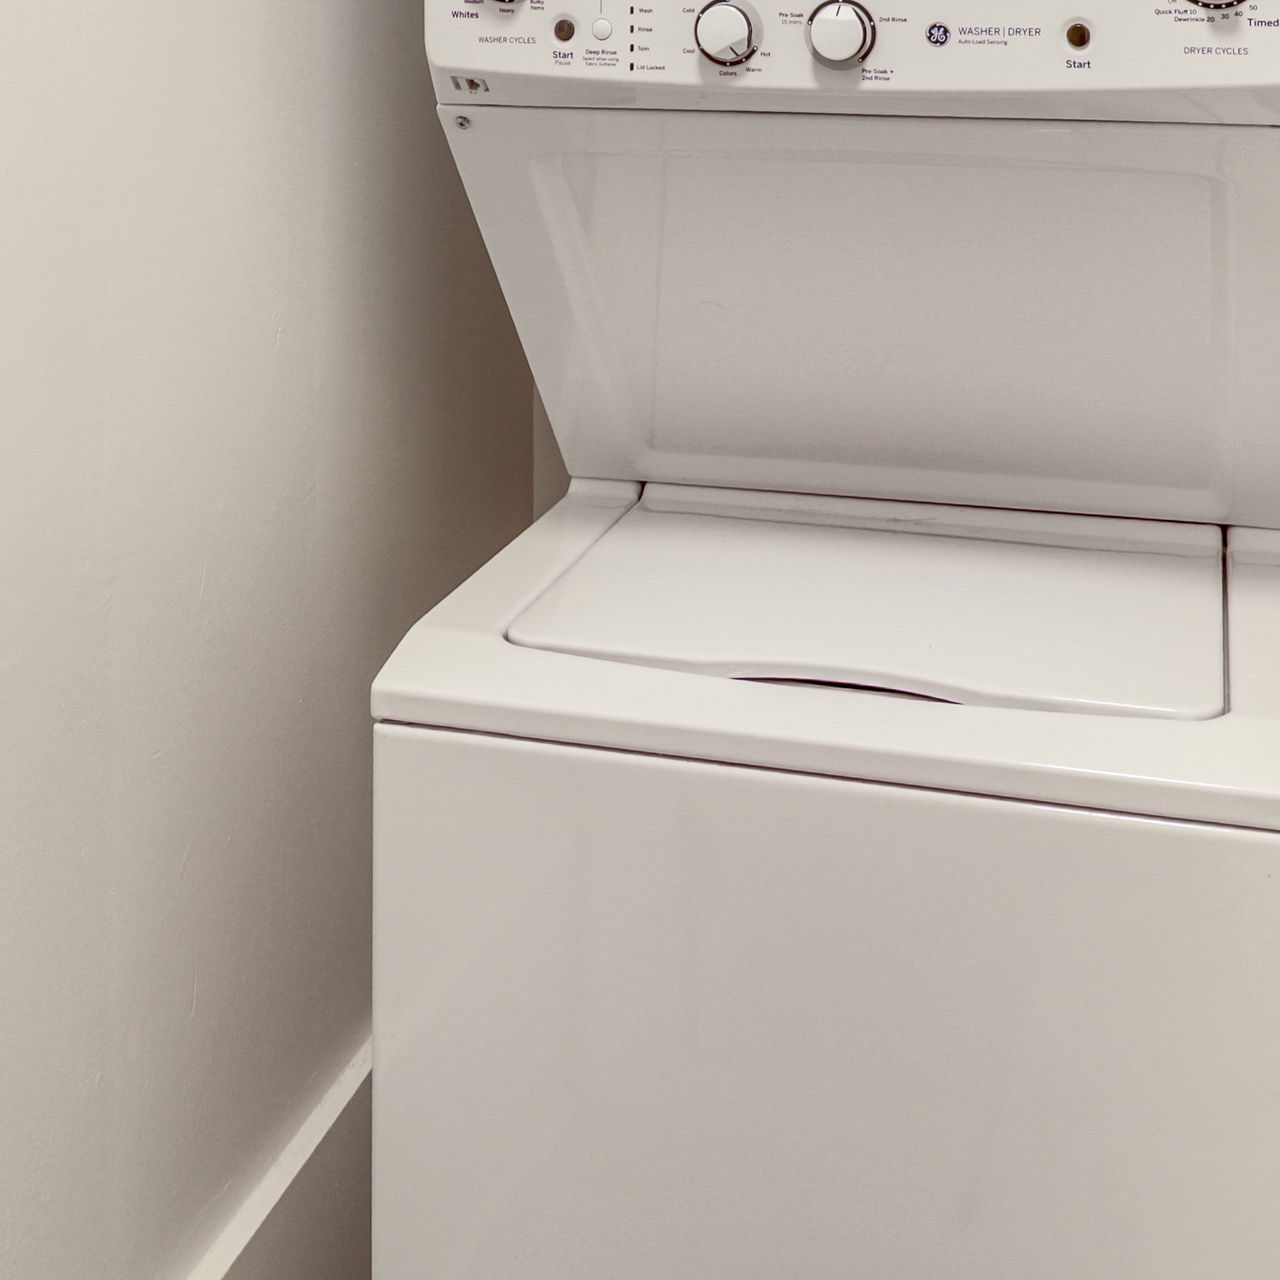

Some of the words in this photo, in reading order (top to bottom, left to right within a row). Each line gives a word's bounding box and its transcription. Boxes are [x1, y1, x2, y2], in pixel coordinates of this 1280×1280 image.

[452, 11, 479, 19] Whites
[1248, 18, 1279, 27] Timed
[958, 27, 1000, 36] WASHER
[1008, 27, 1041, 36] DRYER
[478, 36, 507, 44] WASHER
[509, 36, 537, 44] CYCLES
[552, 50, 574, 59] Start
[1183, 47, 1213, 55] DRYER
[1215, 47, 1249, 55] CYCLES
[1066, 60, 1091, 69] Start
